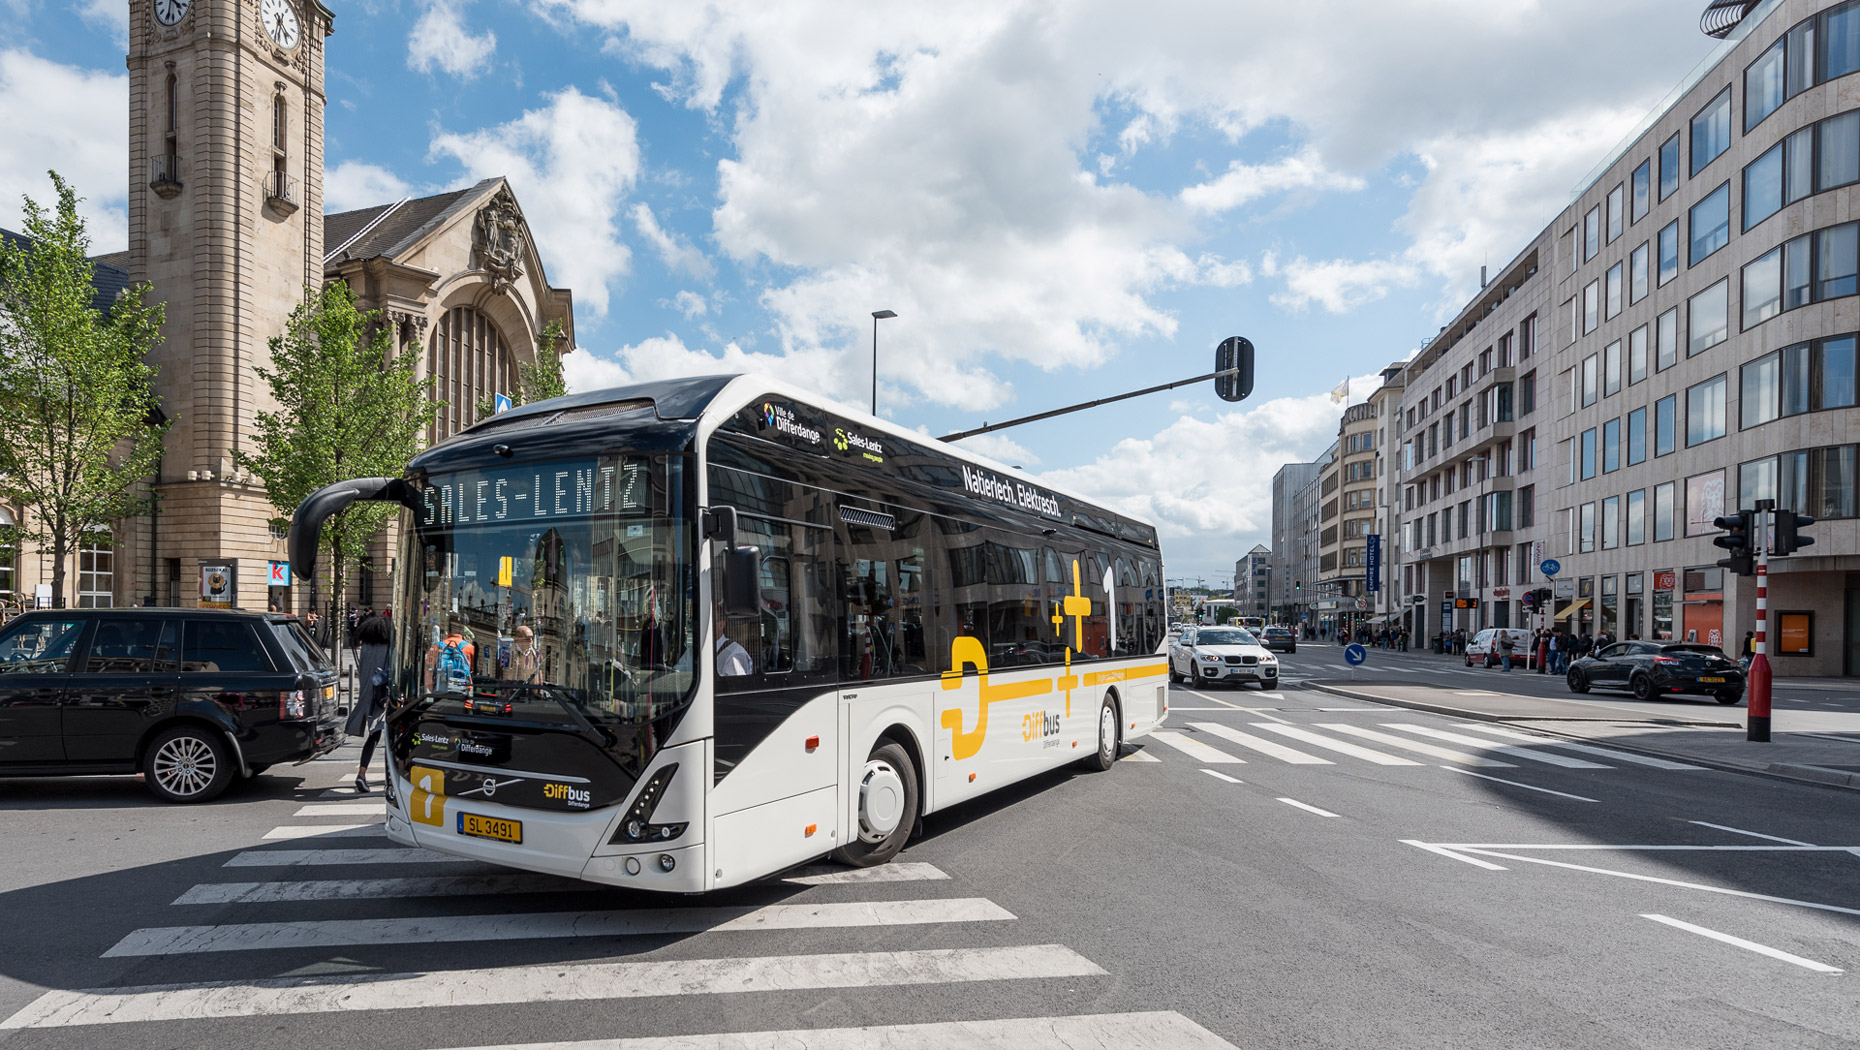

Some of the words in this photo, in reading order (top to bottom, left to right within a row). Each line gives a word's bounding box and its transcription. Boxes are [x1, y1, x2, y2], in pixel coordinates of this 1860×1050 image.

[774, 405, 787, 418] Ville
[787, 410, 795, 420] de
[776, 415, 820, 444] Differdange
[847, 431, 883, 454] Sales-Lentz
[423, 463, 638, 525] SALES-LENTZ
[962, 464, 1017, 505] Natierlech.
[1016, 483, 1062, 518] Elektresch.
[1021, 710, 1060, 742] Diffbus
[419, 775, 435, 819] 1
[543, 783, 590, 802] Diffbus
[469, 817, 482, 834] SL
[485, 821, 513, 838] 3491
